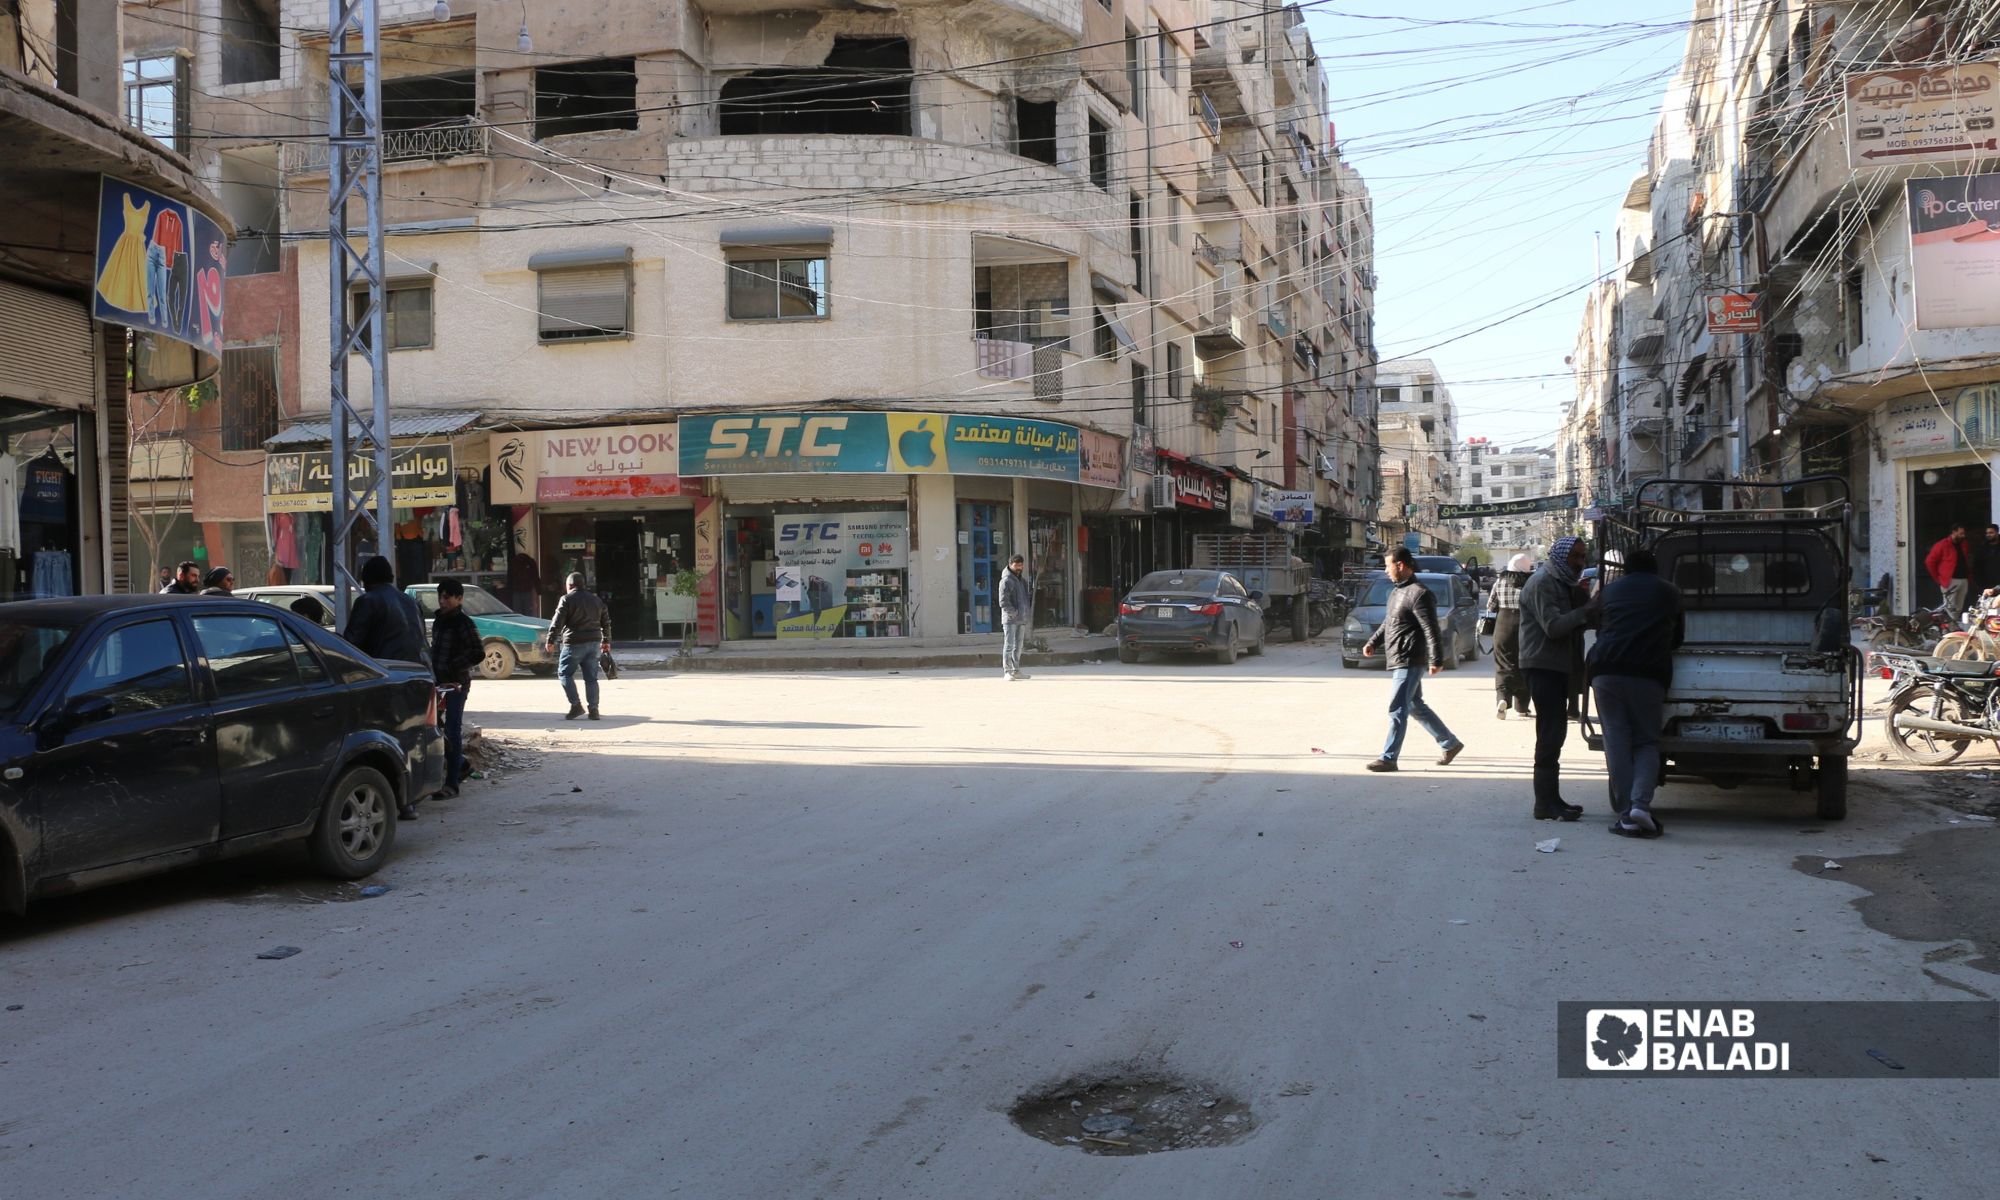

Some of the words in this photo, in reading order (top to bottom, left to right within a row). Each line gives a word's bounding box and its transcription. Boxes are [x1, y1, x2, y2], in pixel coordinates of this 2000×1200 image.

[1859, 82, 1914, 106] عبيد
[1932, 106, 1964, 118] مسرات
[1727, 309, 1757, 321] النجار
[704, 416, 849, 459] S.T.C
[954, 423, 1011, 444] معتمد
[1015, 425, 1054, 453] صيانة
[1055, 431, 1077, 454] مركز
[547, 437, 601, 459] NEW
[606, 433, 675, 455] LOOK
[308, 456, 370, 486] المبة
[391, 453, 448, 481] مواس
[586, 459, 615, 475] لوك
[618, 458, 644, 474] نيو
[35, 470, 63, 484] FIGHT
[1177, 471, 1212, 504] مايسترو
[1279, 493, 1312, 502] الصادق
[1502, 501, 1536, 513] مول
[780, 523, 840, 541] STC
